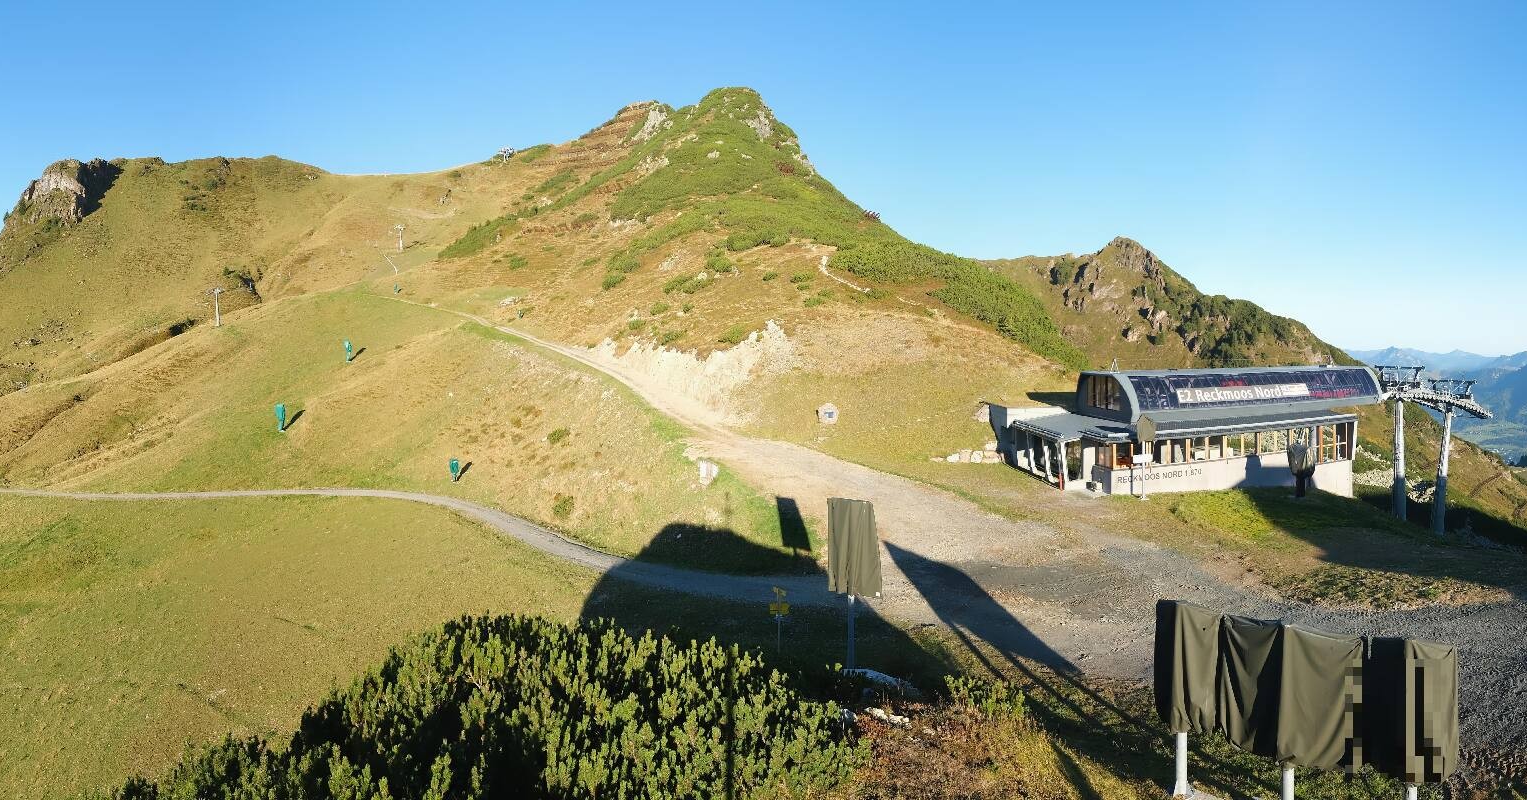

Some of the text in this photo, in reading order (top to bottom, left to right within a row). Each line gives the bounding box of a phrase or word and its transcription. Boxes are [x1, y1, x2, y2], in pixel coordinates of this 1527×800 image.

[1177, 389, 1193, 402] E2
[1194, 387, 1254, 401] Reckmoos
[1254, 384, 1283, 398] Nord
[1162, 470, 1183, 479] NORD
